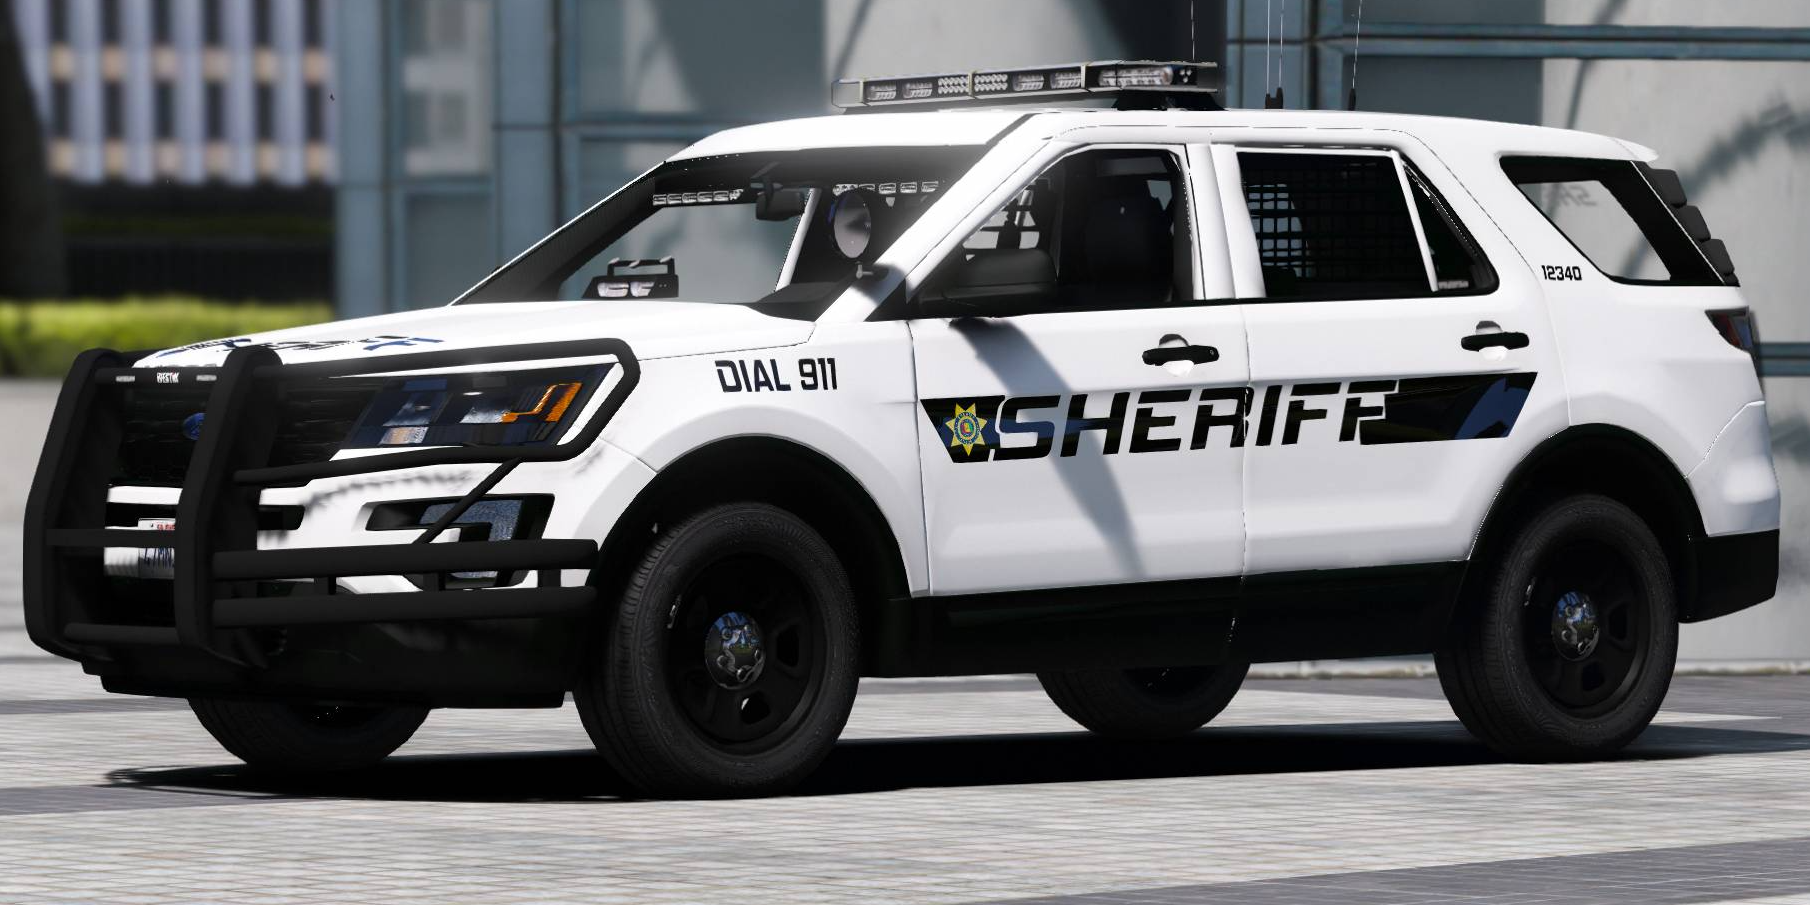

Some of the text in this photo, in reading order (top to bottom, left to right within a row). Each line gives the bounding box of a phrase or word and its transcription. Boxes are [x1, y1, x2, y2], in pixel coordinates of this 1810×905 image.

[1541, 264, 1582, 281] 12340
[715, 357, 838, 393] DIAL 911
[993, 379, 1398, 461] SHERIFF
